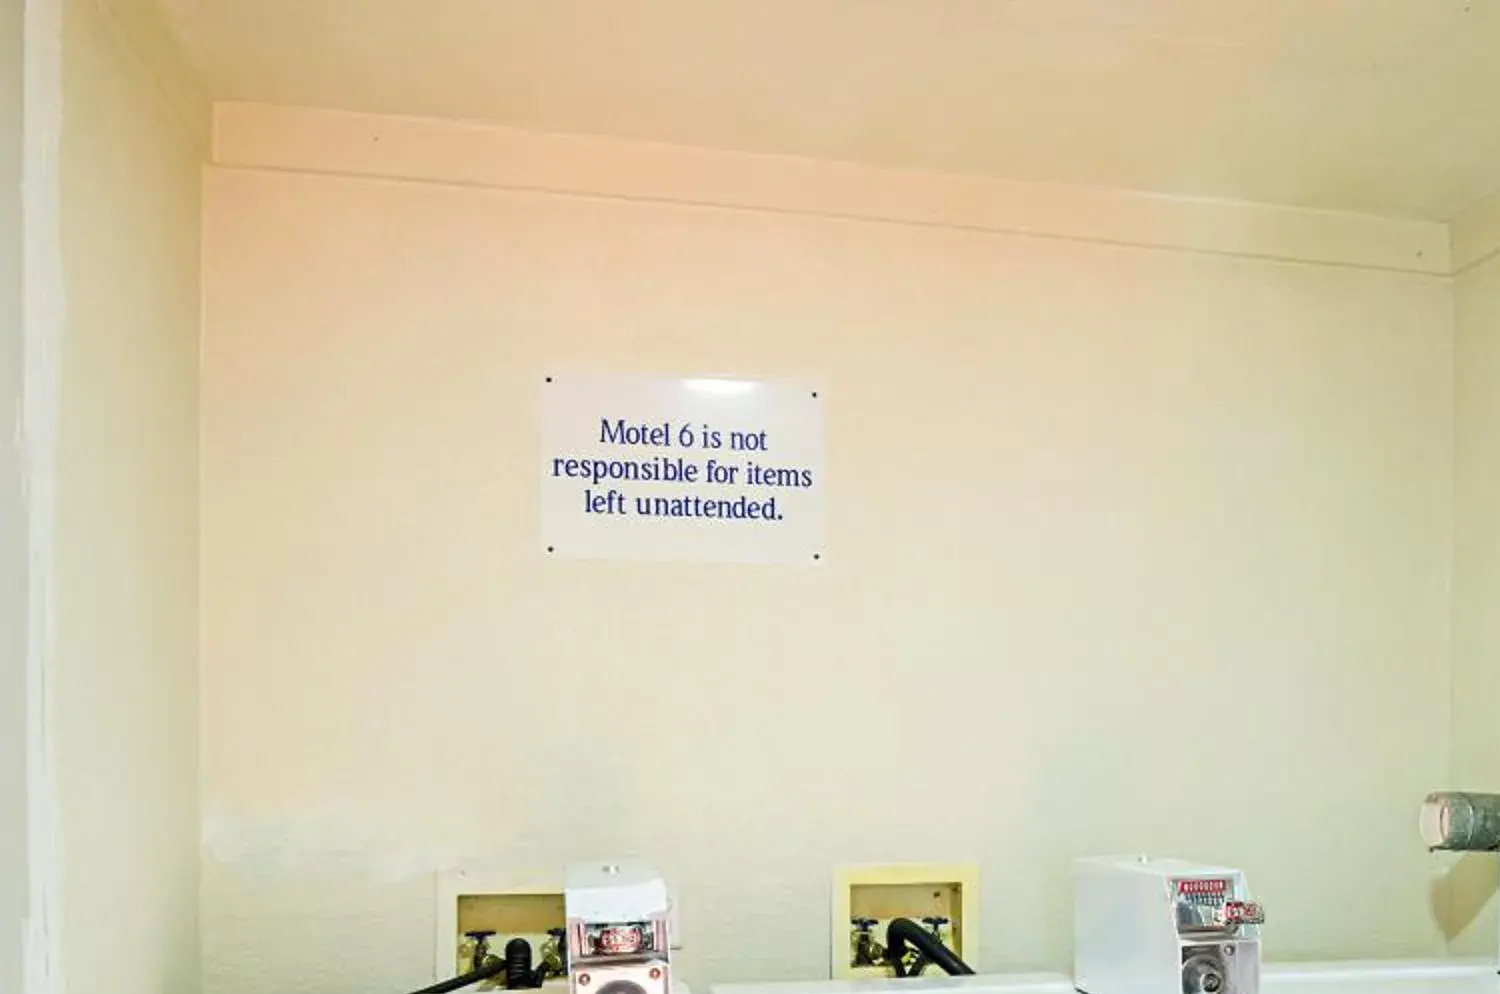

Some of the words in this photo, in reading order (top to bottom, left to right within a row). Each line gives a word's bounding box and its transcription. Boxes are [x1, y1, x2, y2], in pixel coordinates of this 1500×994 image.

[600, 418, 670, 447] Motel
[678, 424, 695, 448] 6
[702, 423, 722, 449] is
[730, 429, 768, 451] not
[552, 456, 699, 485] responsible
[706, 459, 740, 485] for
[747, 461, 813, 487] items
[584, 489, 627, 515] left
[636, 496, 784, 521] unattended.
